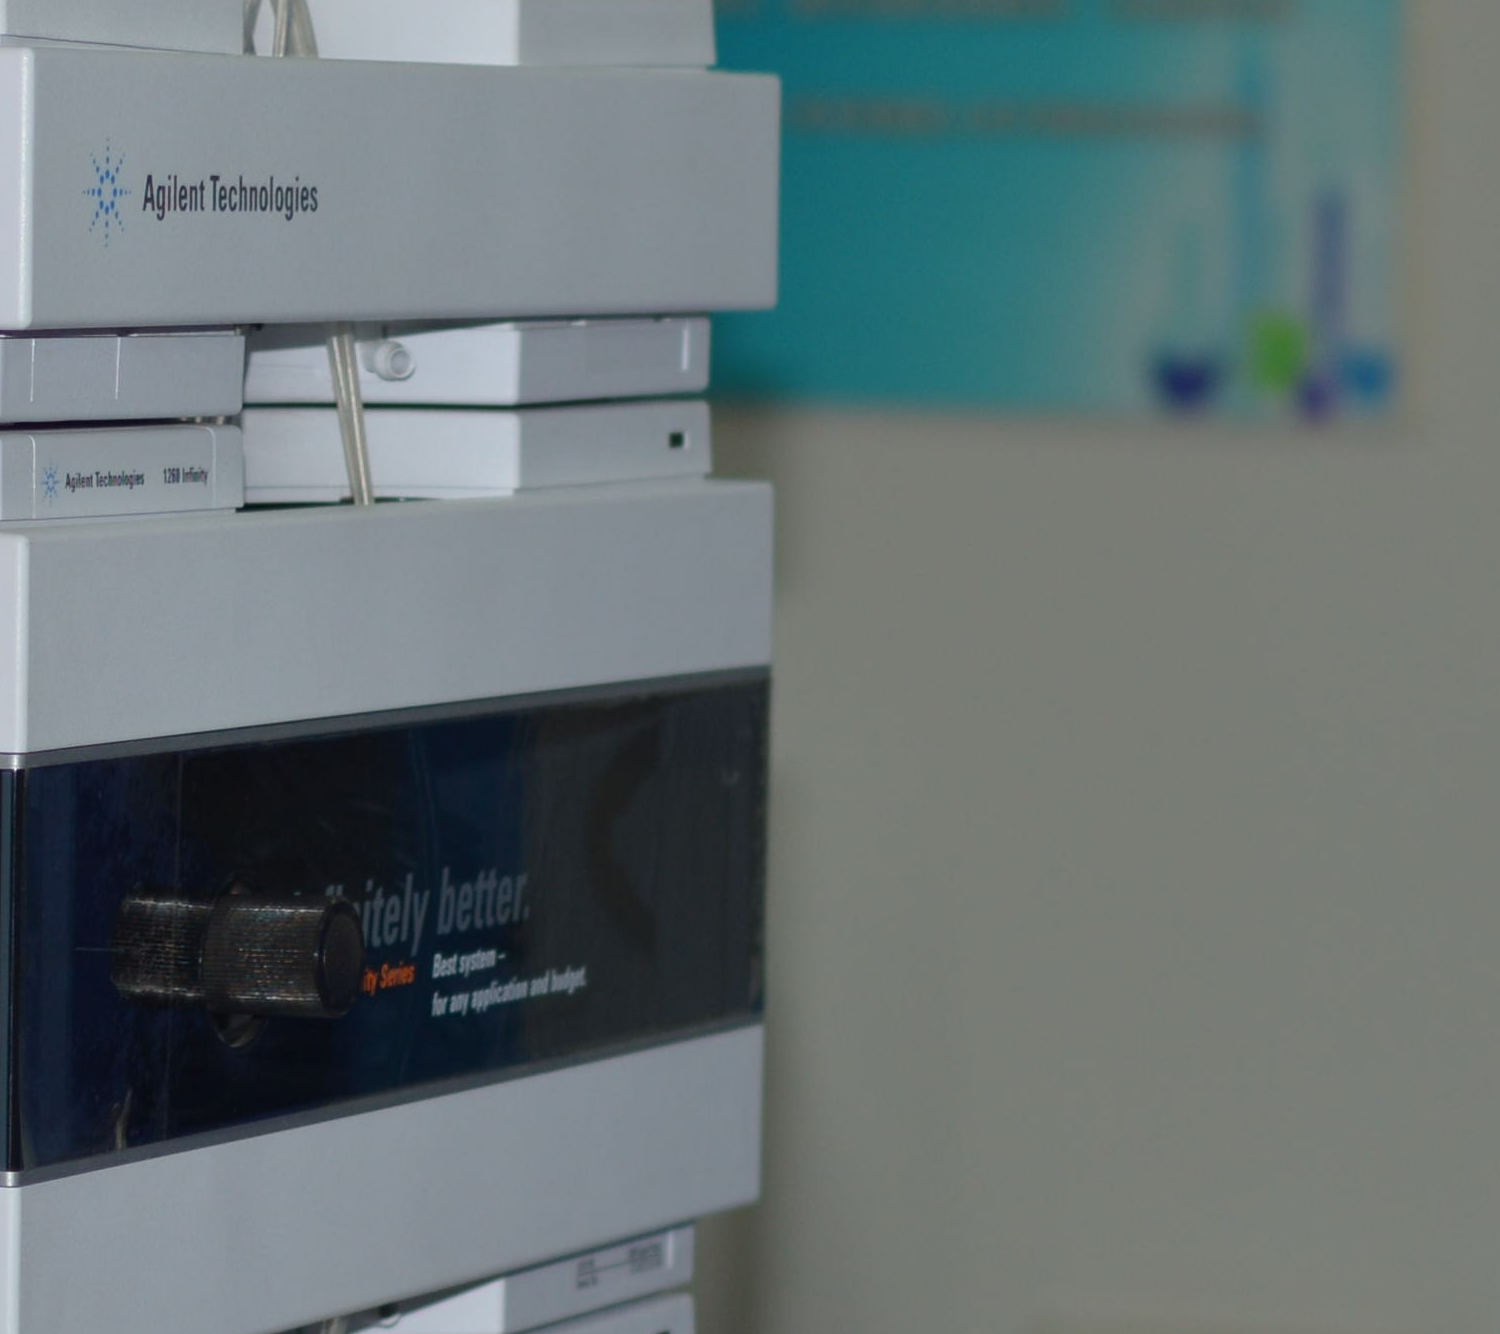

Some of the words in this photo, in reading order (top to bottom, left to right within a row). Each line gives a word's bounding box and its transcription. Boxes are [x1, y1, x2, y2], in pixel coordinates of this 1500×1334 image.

[142, 174, 205, 221] Agilent
[209, 175, 318, 221] Technologies
[65, 472, 93, 493] Agilent
[95, 470, 145, 490] Technologies
[437, 866, 530, 936] better.
[379, 963, 416, 990] Series
[432, 953, 458, 979] Best
[458, 947, 497, 978] system
[431, 990, 448, 1016] for
[449, 993, 470, 1016] any
[470, 976, 529, 1014] application
[529, 969, 550, 997] and
